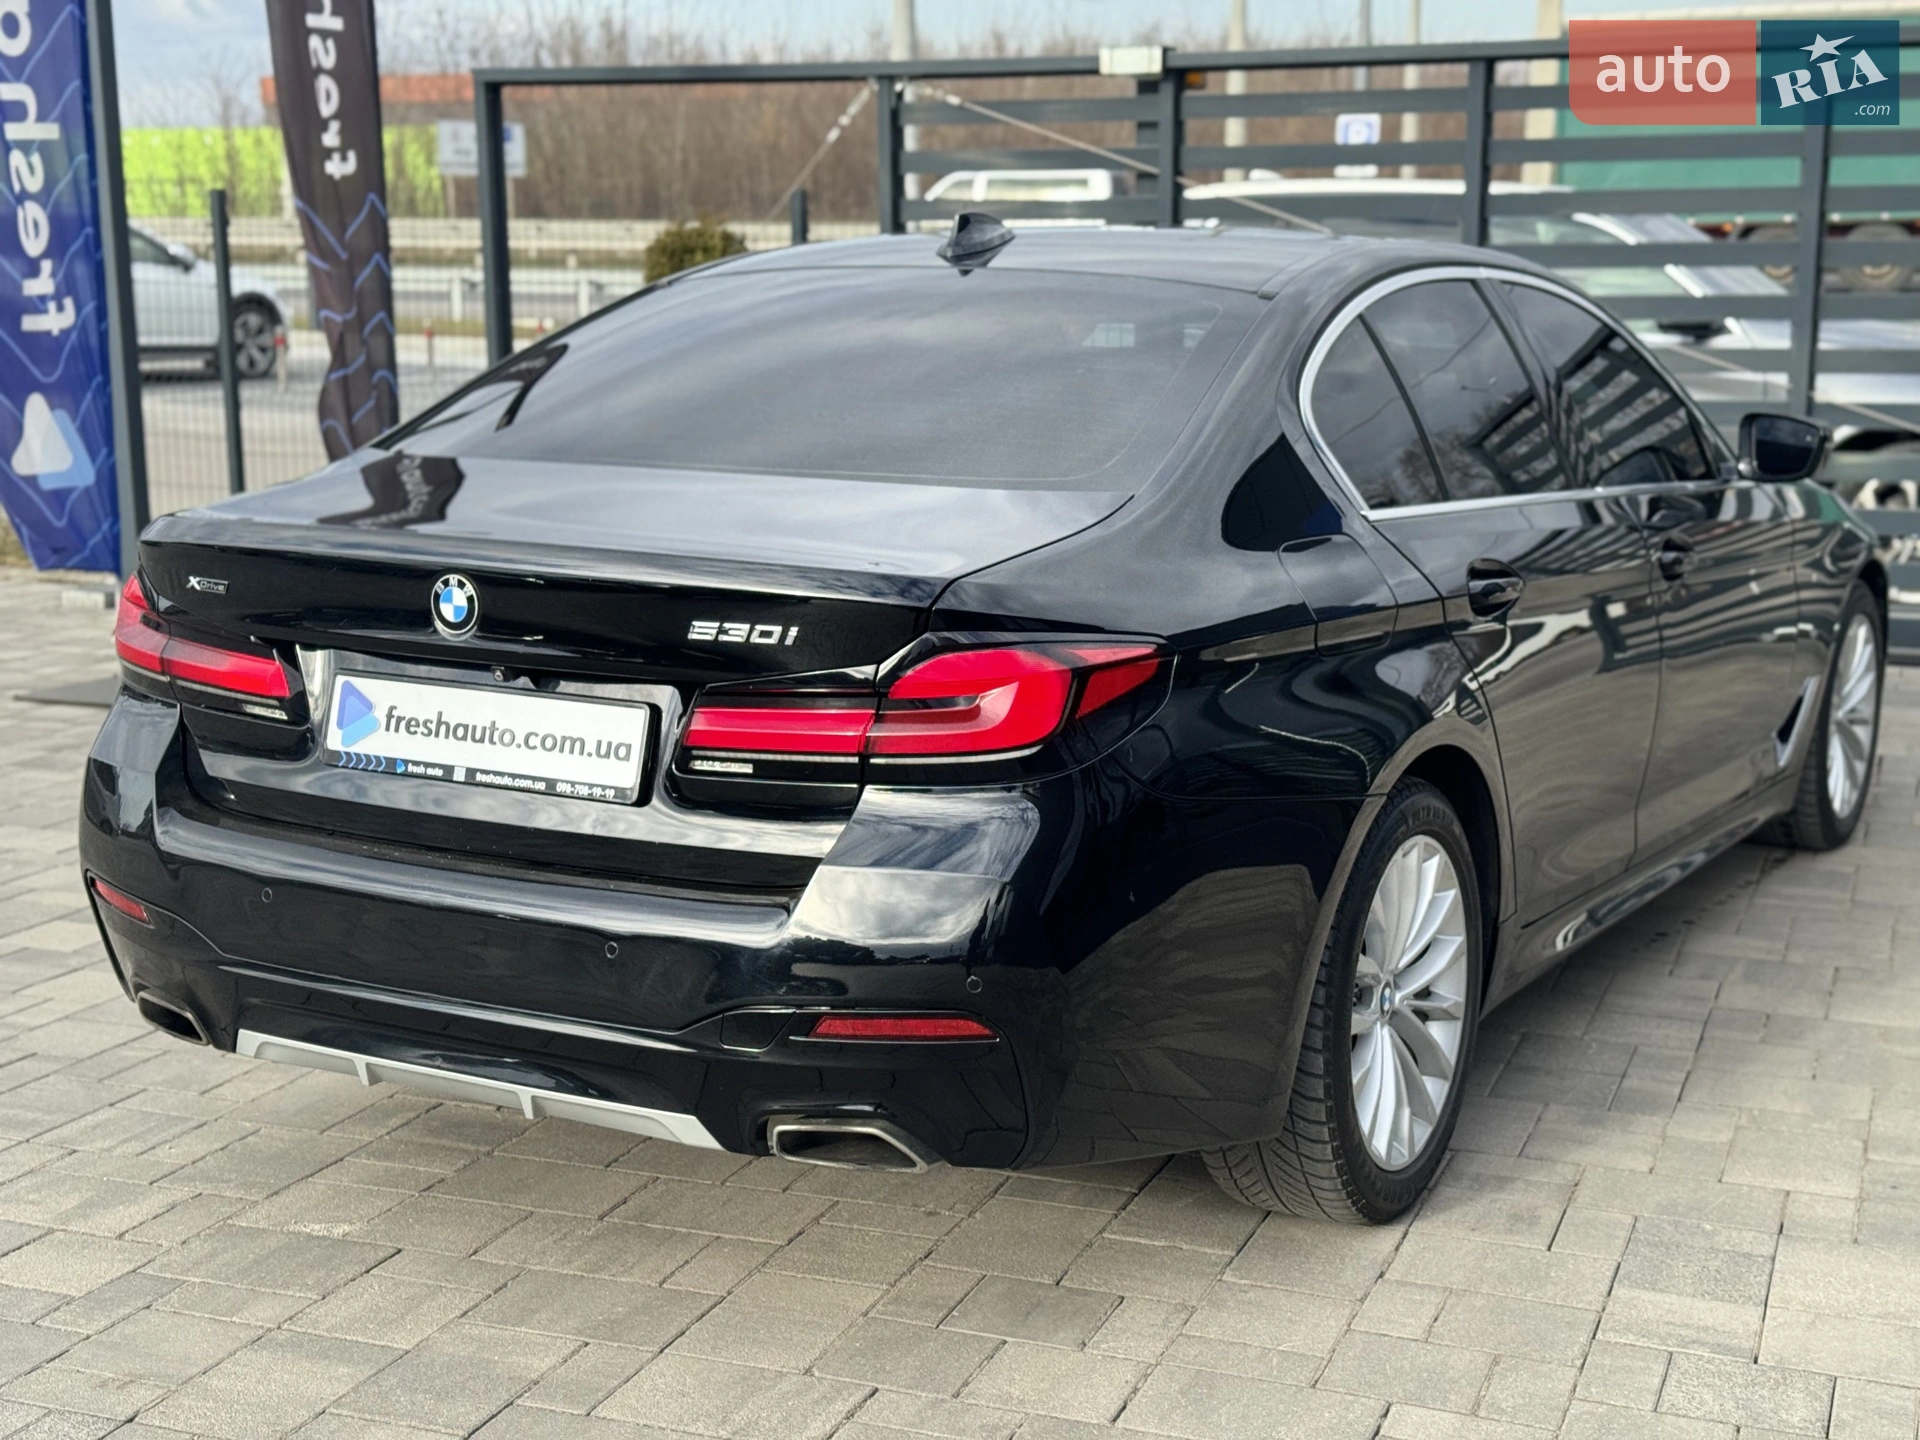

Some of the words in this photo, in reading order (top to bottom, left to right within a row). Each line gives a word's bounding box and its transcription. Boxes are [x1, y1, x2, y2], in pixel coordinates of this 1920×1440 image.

[687, 621, 799, 645] 530i
[384, 705, 632, 762] freshauto.com.ua
[407, 762, 425, 774] fresh
[426, 766, 444, 777] auto
[475, 771, 546, 790] freshauto.com.ua
